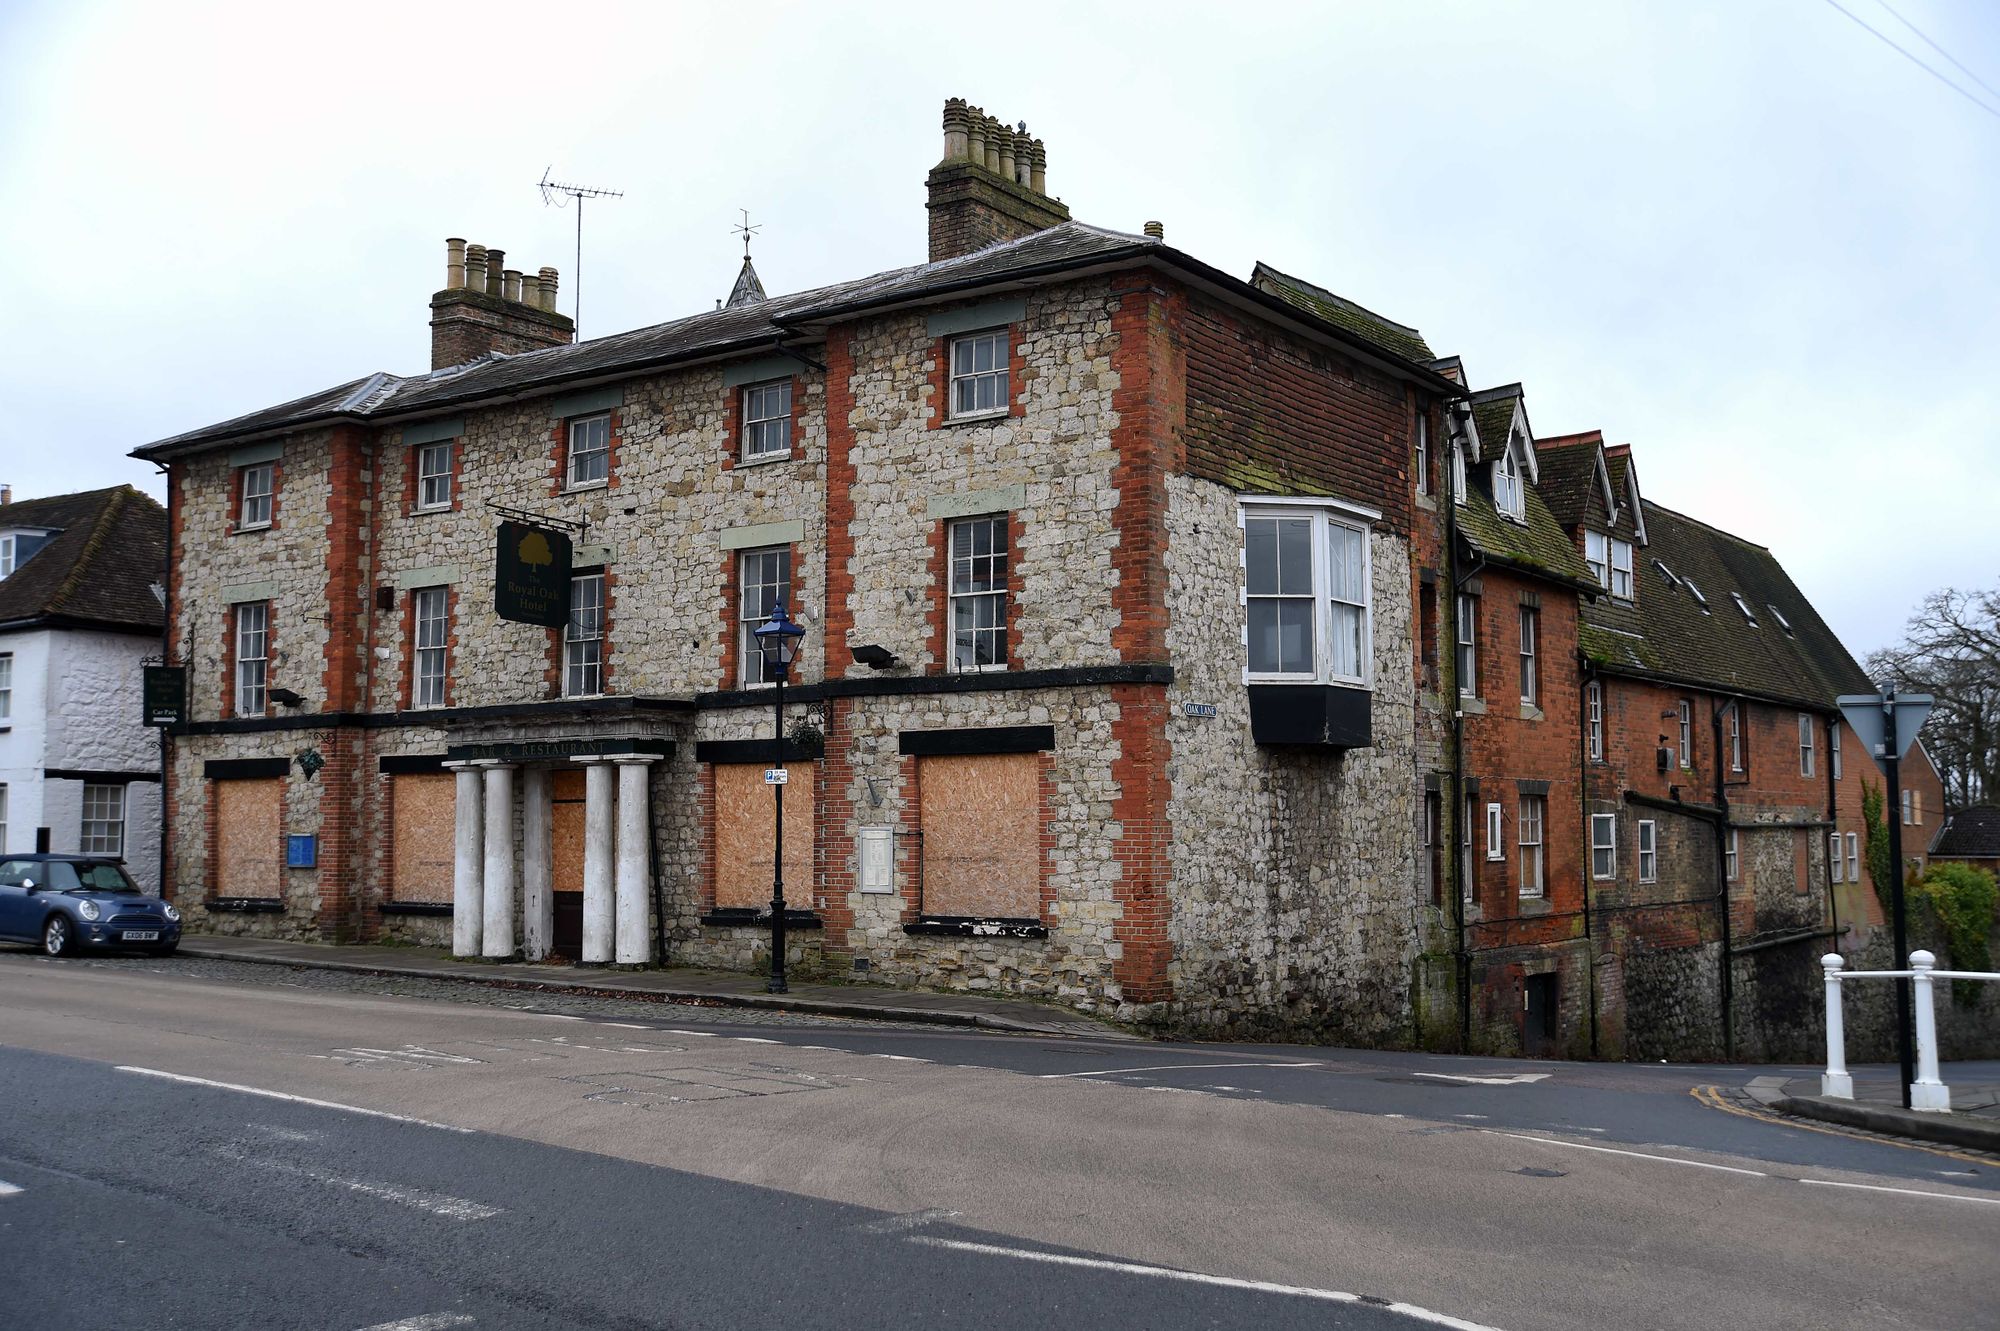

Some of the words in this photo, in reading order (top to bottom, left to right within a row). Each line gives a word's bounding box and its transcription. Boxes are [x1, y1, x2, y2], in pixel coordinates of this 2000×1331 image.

[508, 582, 537, 596] Royal
[539, 586, 560, 600] Oak
[520, 599, 548, 610] Hotel
[1187, 704, 1199, 714] OAK
[1200, 705, 1215, 715] LANE
[472, 747, 495, 758] BAR
[504, 746, 513, 756] &
[522, 743, 605, 756] RESTAURANT
